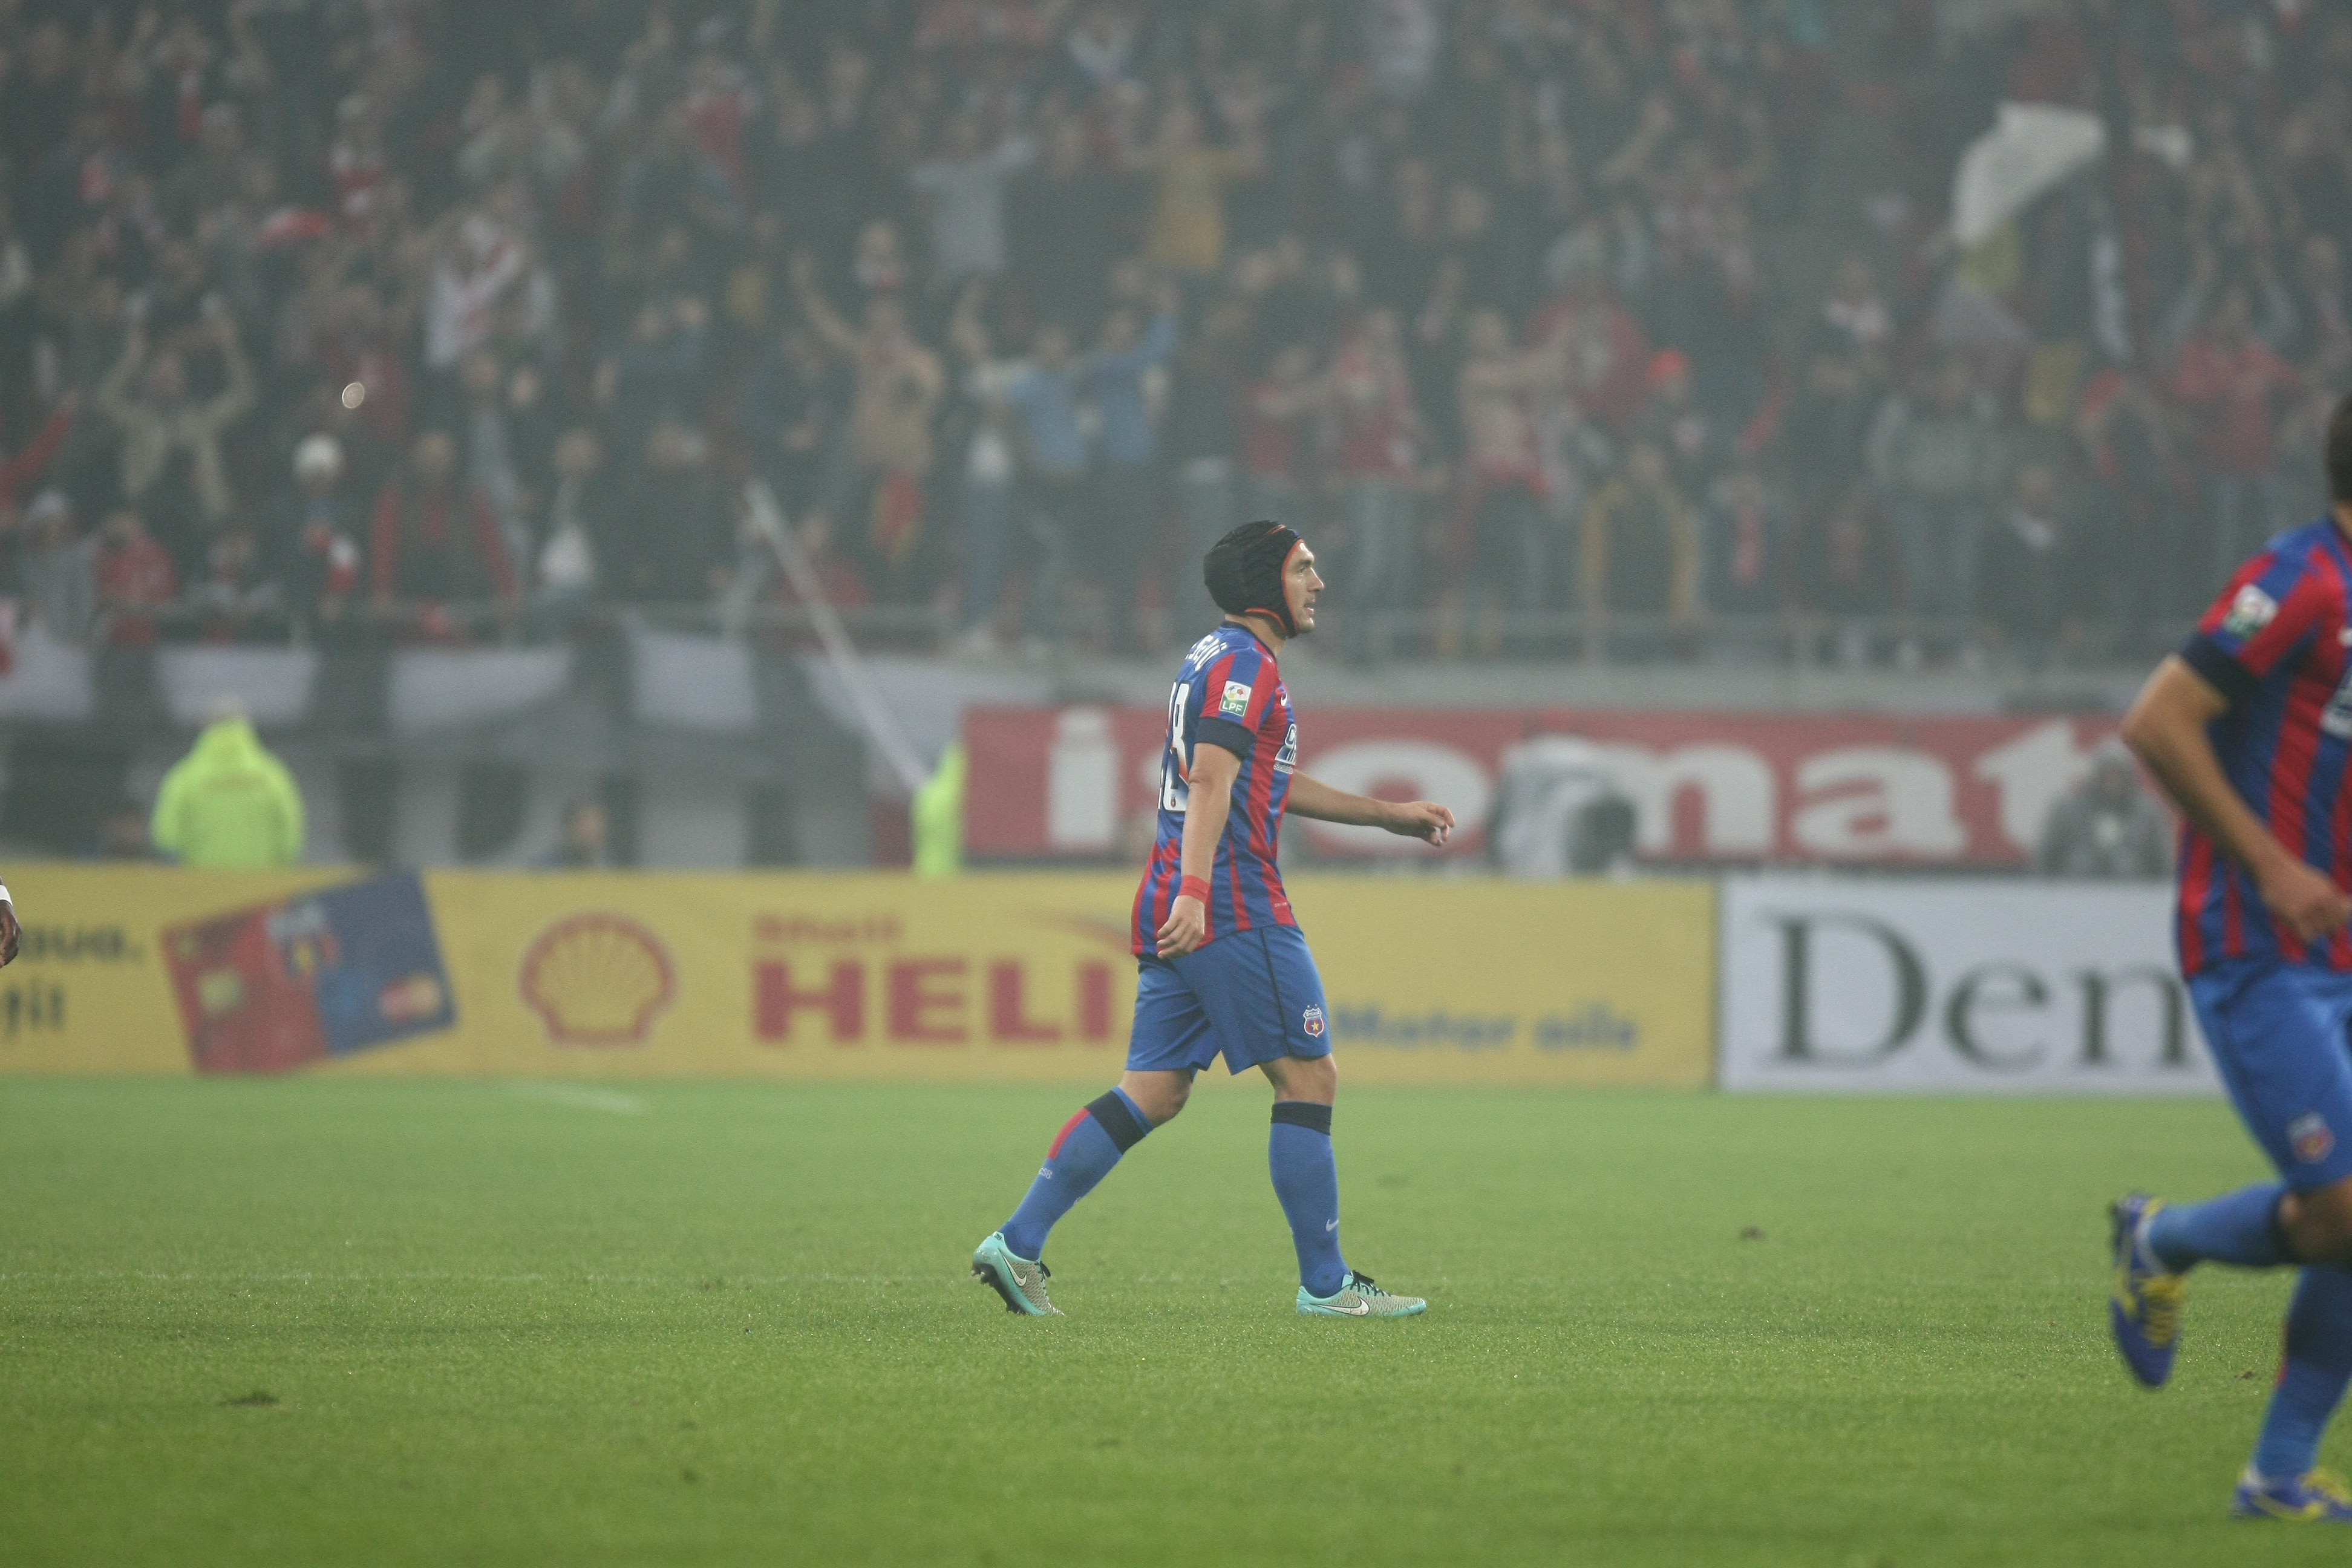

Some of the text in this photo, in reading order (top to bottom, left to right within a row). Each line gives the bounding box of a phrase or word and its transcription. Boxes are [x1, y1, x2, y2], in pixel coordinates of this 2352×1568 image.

[1222, 700, 1243, 713] LPF
[1044, 709, 2123, 854] iomat
[1756, 910, 2197, 1070] Den
